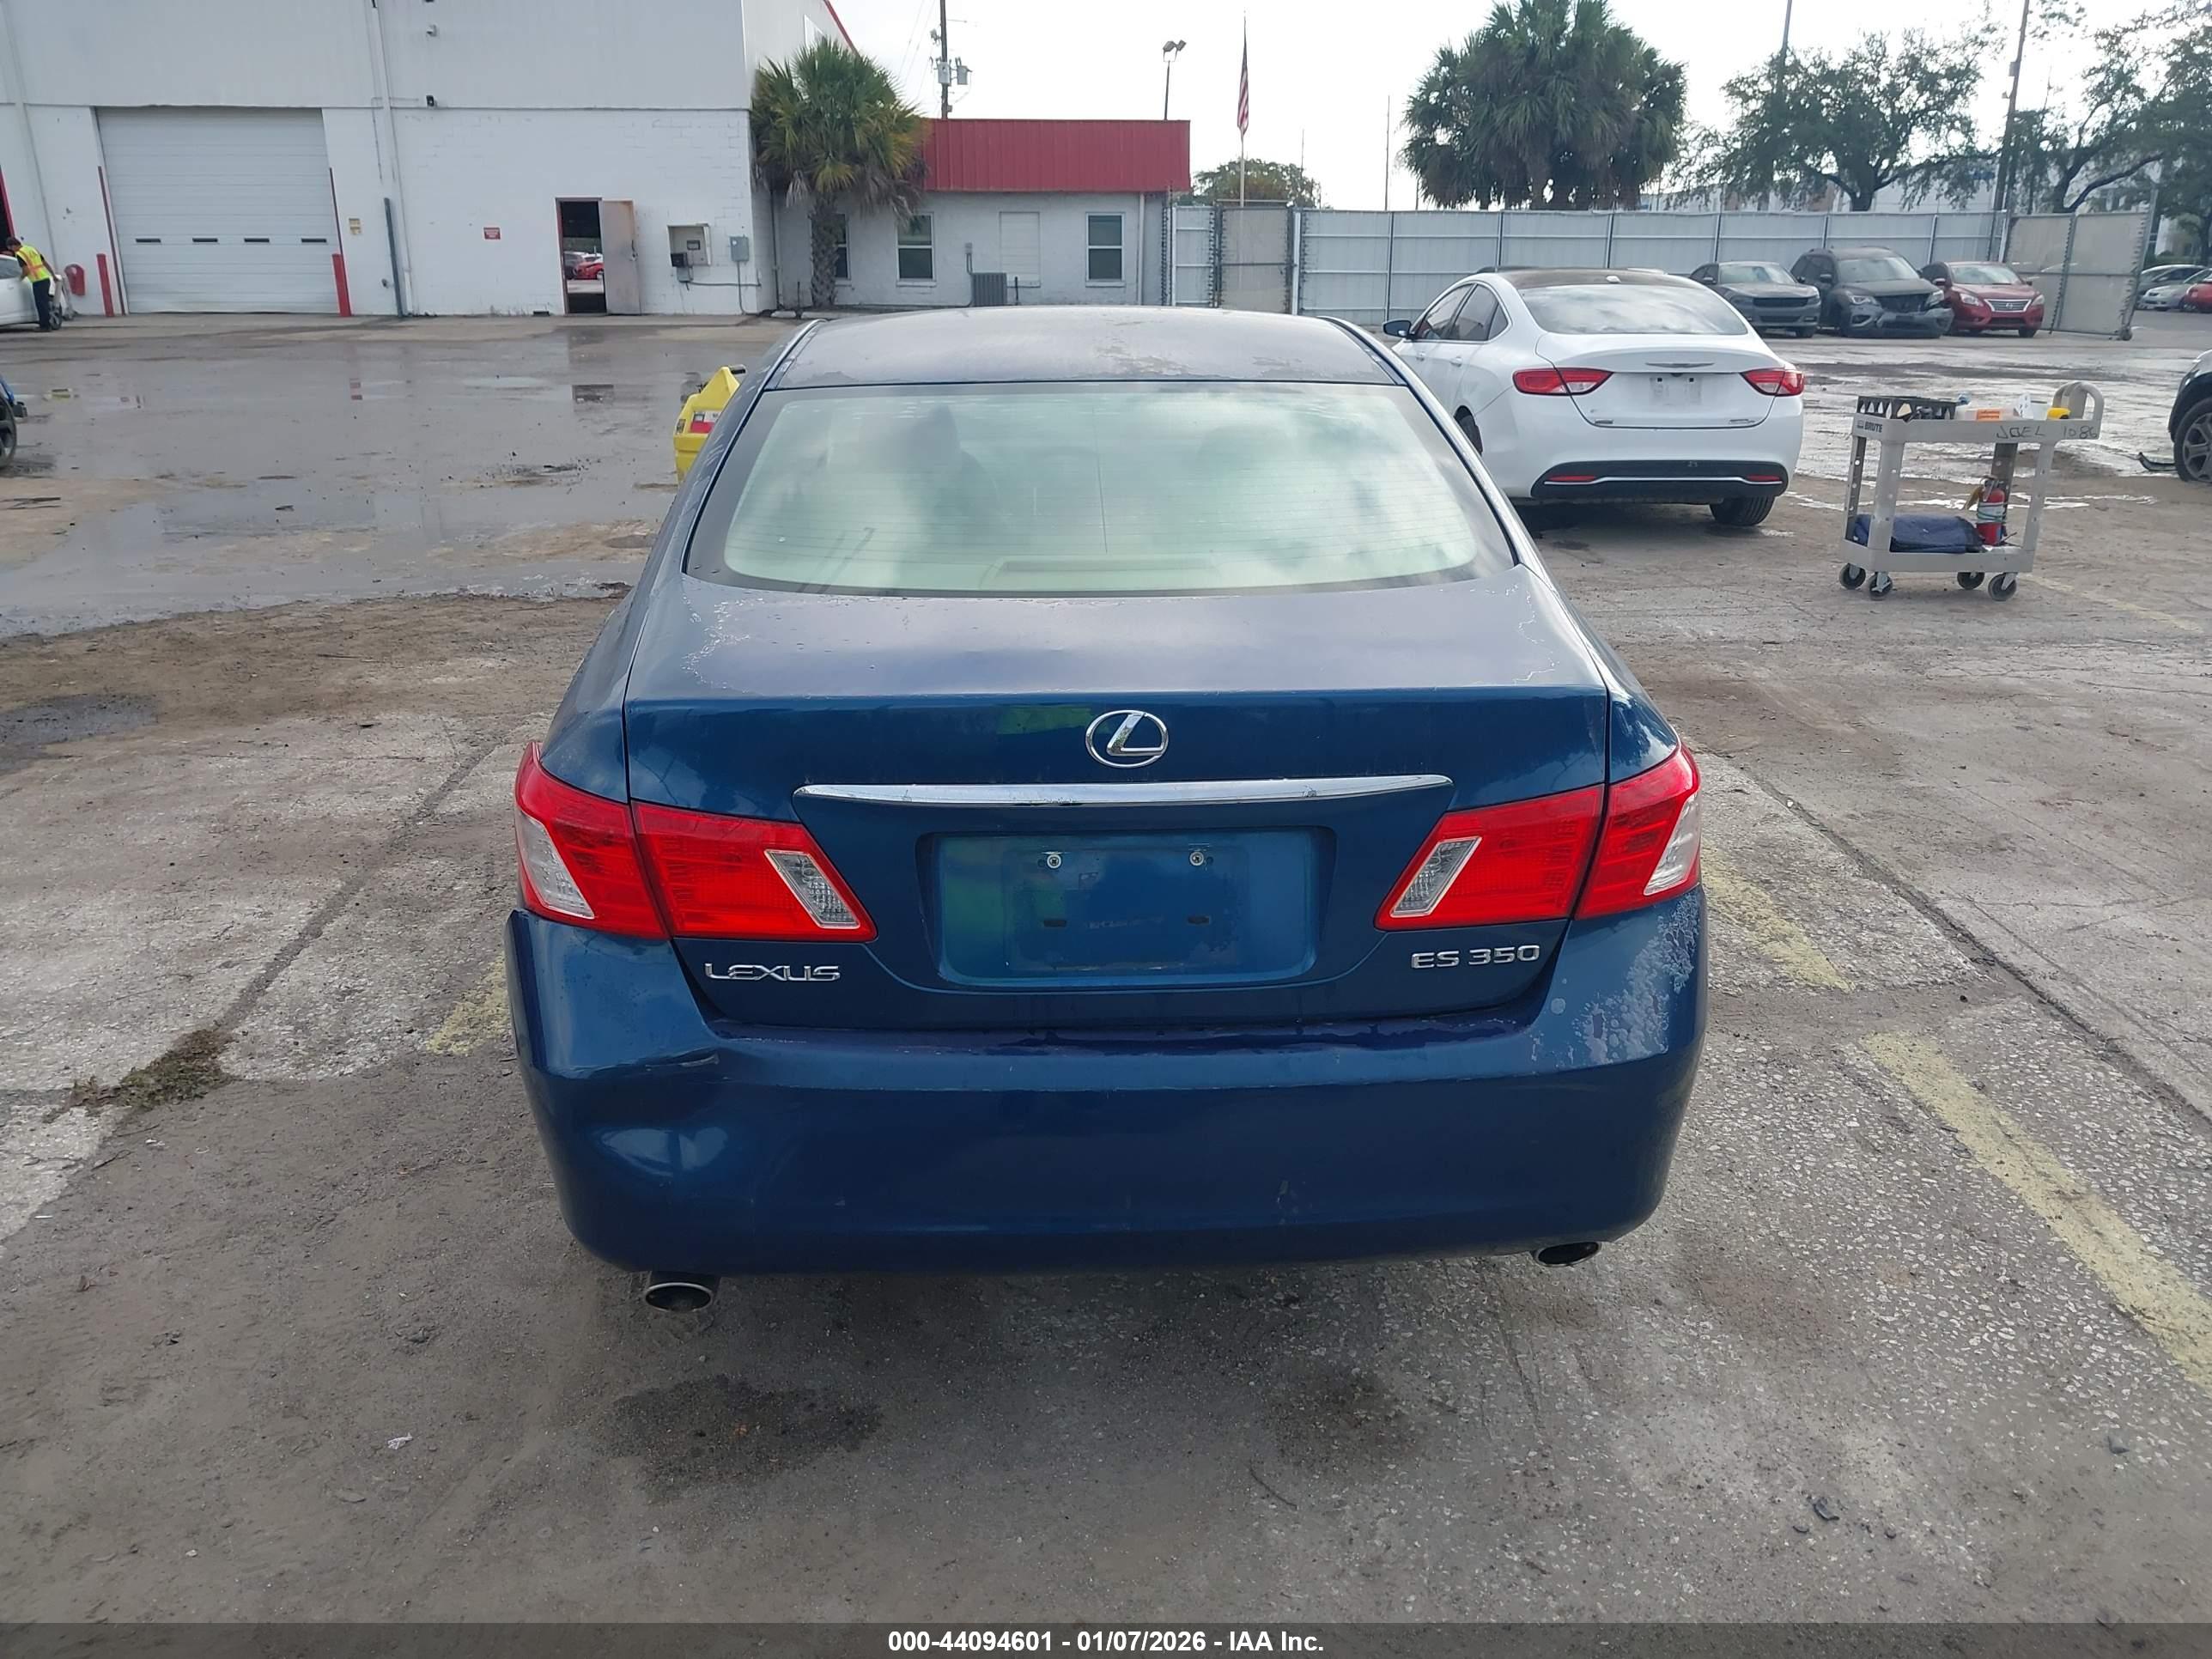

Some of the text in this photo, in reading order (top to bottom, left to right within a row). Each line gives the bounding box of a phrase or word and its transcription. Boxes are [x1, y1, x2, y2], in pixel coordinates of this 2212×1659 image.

[1864, 421, 1883, 434] BRUTE
[1996, 425, 2045, 440] JOEL
[1411, 945, 1540, 969] ES 350
[704, 963, 841, 981] LEXUS
